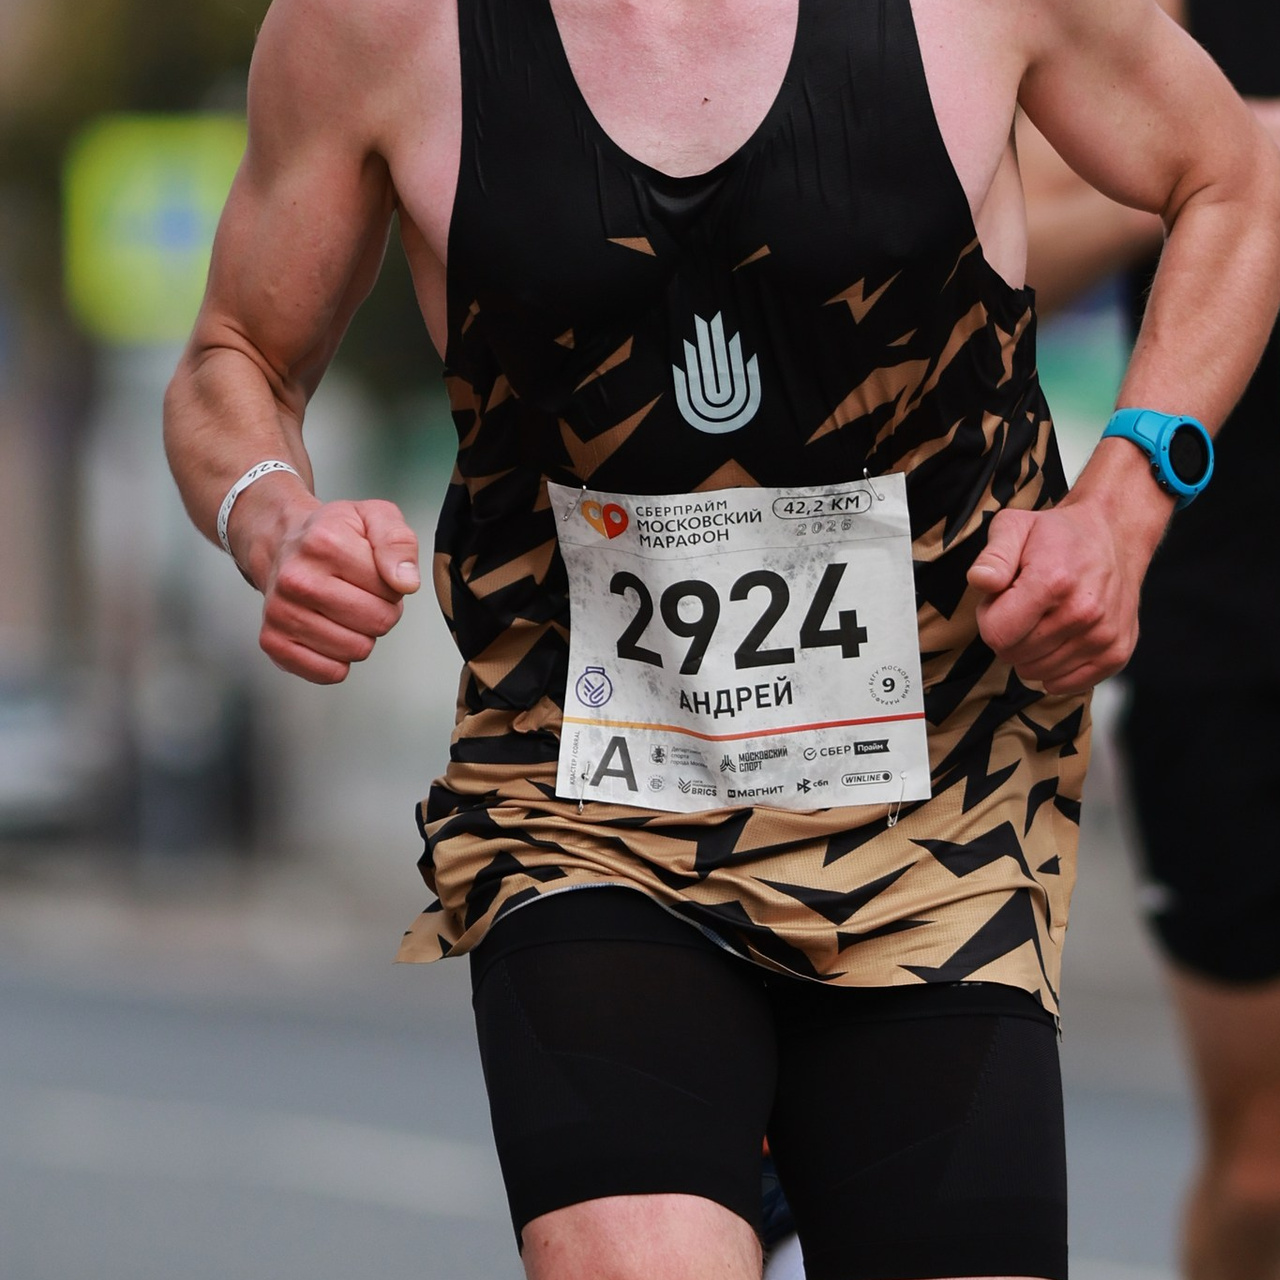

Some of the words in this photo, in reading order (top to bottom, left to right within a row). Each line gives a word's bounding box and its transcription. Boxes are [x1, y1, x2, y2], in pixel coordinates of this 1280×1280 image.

[636, 501, 728, 517] СБЕРПРАЙМ
[783, 500, 823, 515] 42,2
[831, 495, 859, 511] КМ
[637, 509, 762, 533] МОСКОВСКИЙ
[640, 528, 729, 549] МАРАФОН
[609, 562, 868, 675] 2924
[882, 677, 895, 693] 9
[680, 676, 793, 718] АНДРЕЙ
[739, 746, 788, 762] МОСКОВСКИЙ
[820, 745, 851, 757] СБЕР
[857, 744, 884, 753] Прайм
[739, 761, 762, 772] СПОРТ
[845, 774, 881, 784] WINLINE
[692, 787, 717, 797] BRICS
